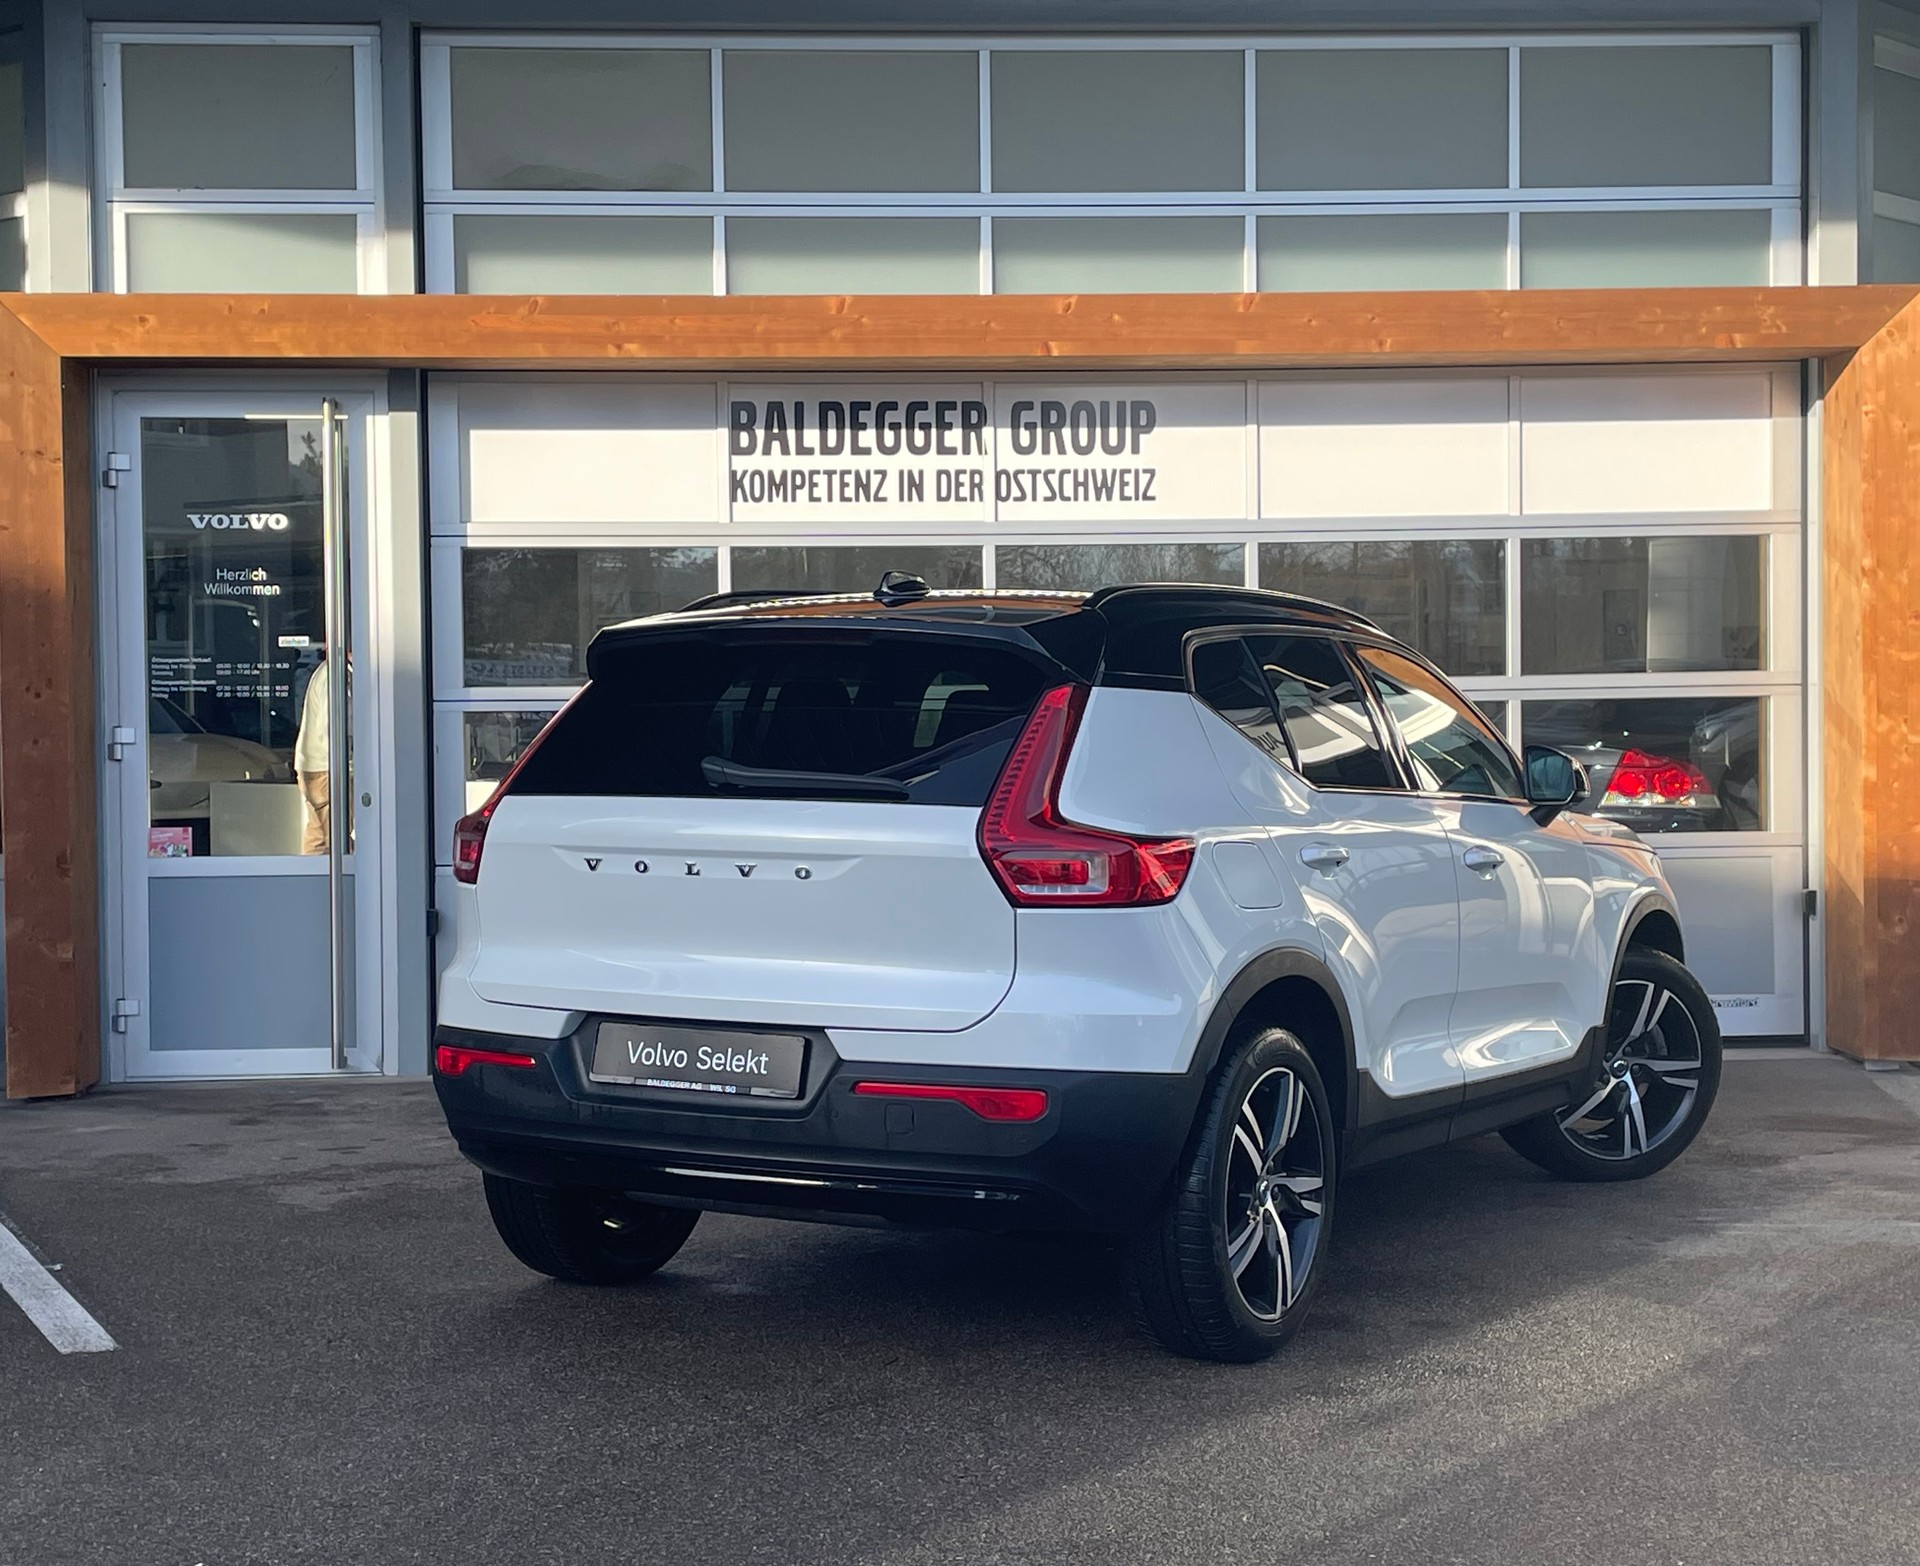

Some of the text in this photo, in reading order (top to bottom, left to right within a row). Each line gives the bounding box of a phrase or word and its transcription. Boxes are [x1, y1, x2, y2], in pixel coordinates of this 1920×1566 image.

[730, 400, 1157, 456] BALDEGGER GROUP
[730, 468, 1157, 502] KOMPETENZ IN DER OSTSCHWEIZ
[186, 513, 289, 530] VOLVO
[215, 567, 267, 581] Herzlich
[203, 583, 281, 596] Willkommen
[584, 857, 813, 880] VOLVO
[627, 1040, 769, 1075] Volvo Selekt
